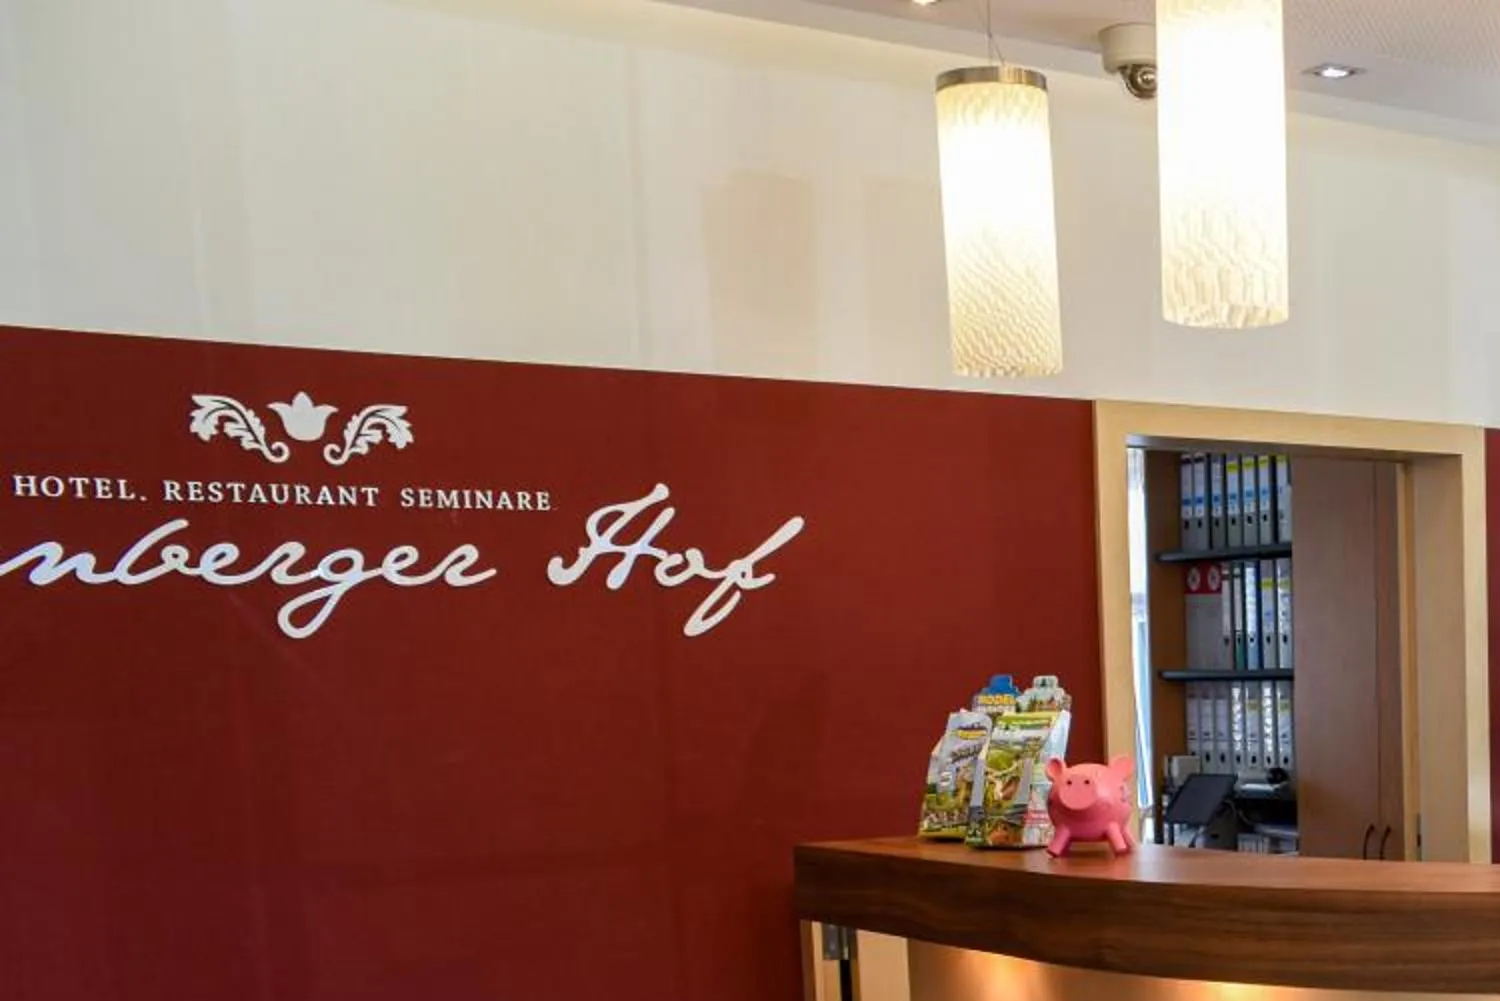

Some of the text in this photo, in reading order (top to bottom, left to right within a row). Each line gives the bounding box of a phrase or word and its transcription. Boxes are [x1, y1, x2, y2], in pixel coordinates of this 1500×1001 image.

[13, 474, 551, 511] HOTEL. RESTAURANT SEMINARE
[546, 482, 805, 637] Hof
